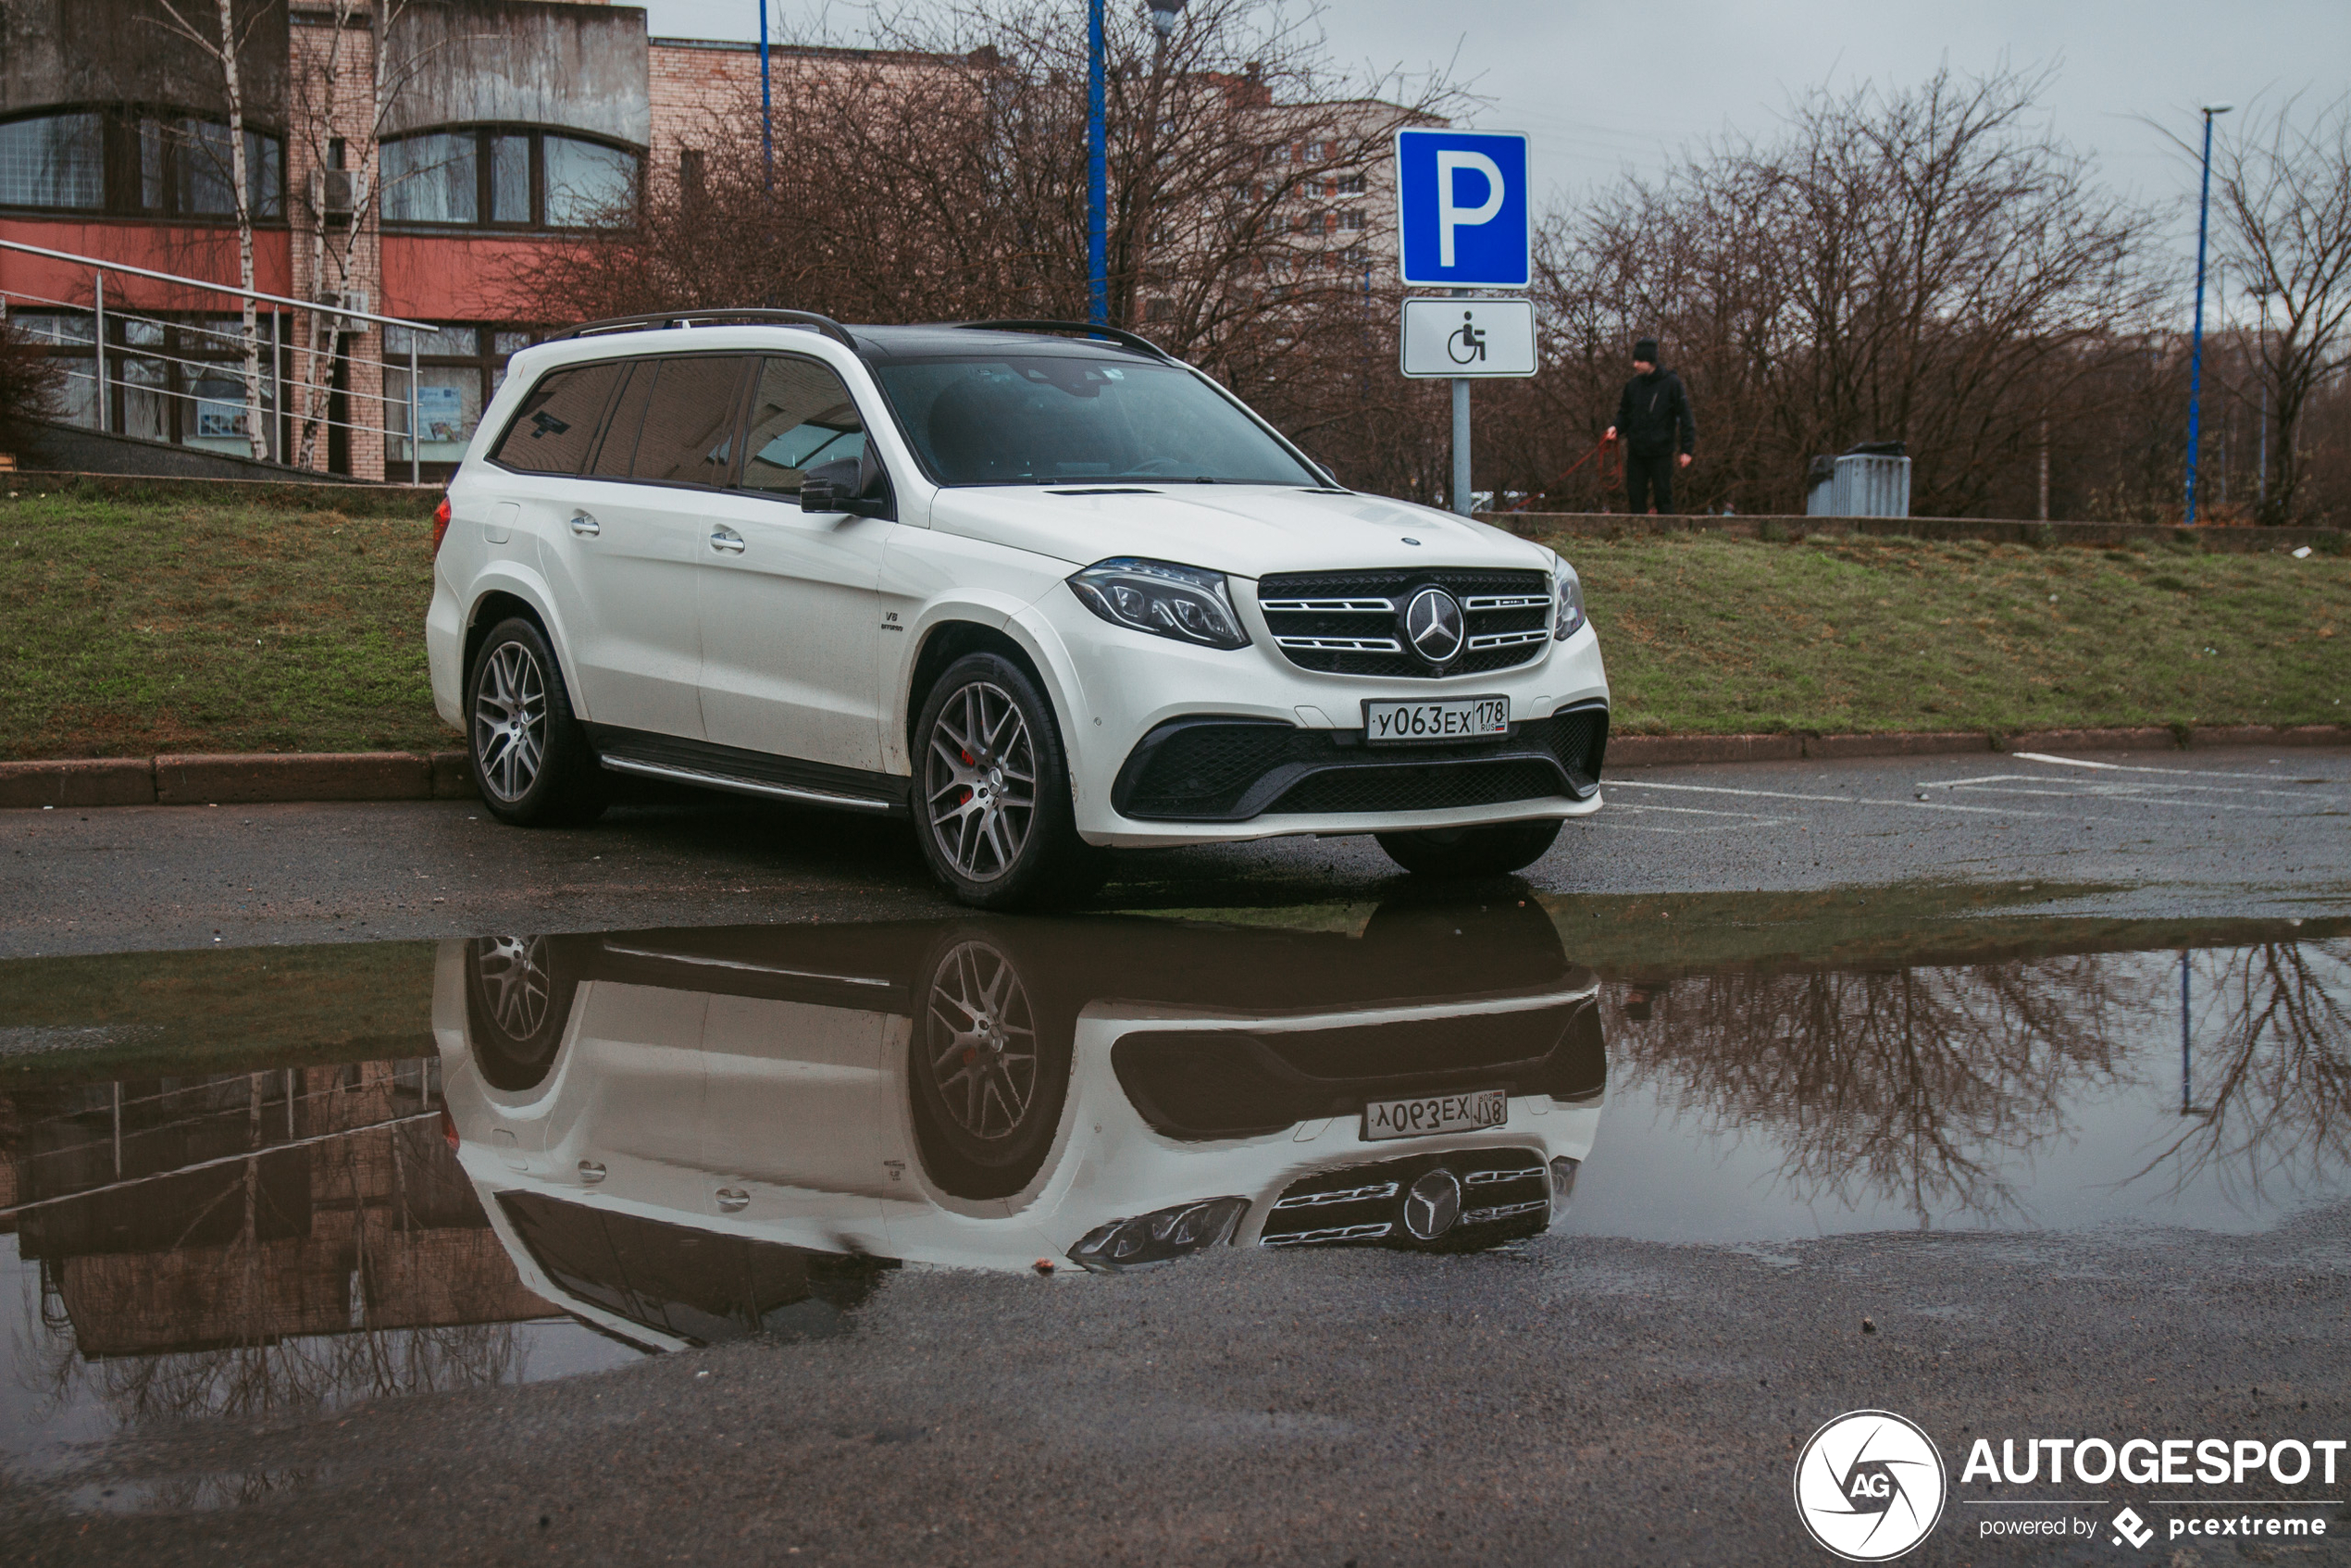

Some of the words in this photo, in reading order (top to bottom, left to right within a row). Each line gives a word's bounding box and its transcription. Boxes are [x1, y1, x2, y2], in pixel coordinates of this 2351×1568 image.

[1437, 150, 1505, 268] P
[886, 612, 898, 621] V8
[1476, 701, 1504, 724] 178
[1481, 724, 1495, 732] RUS
